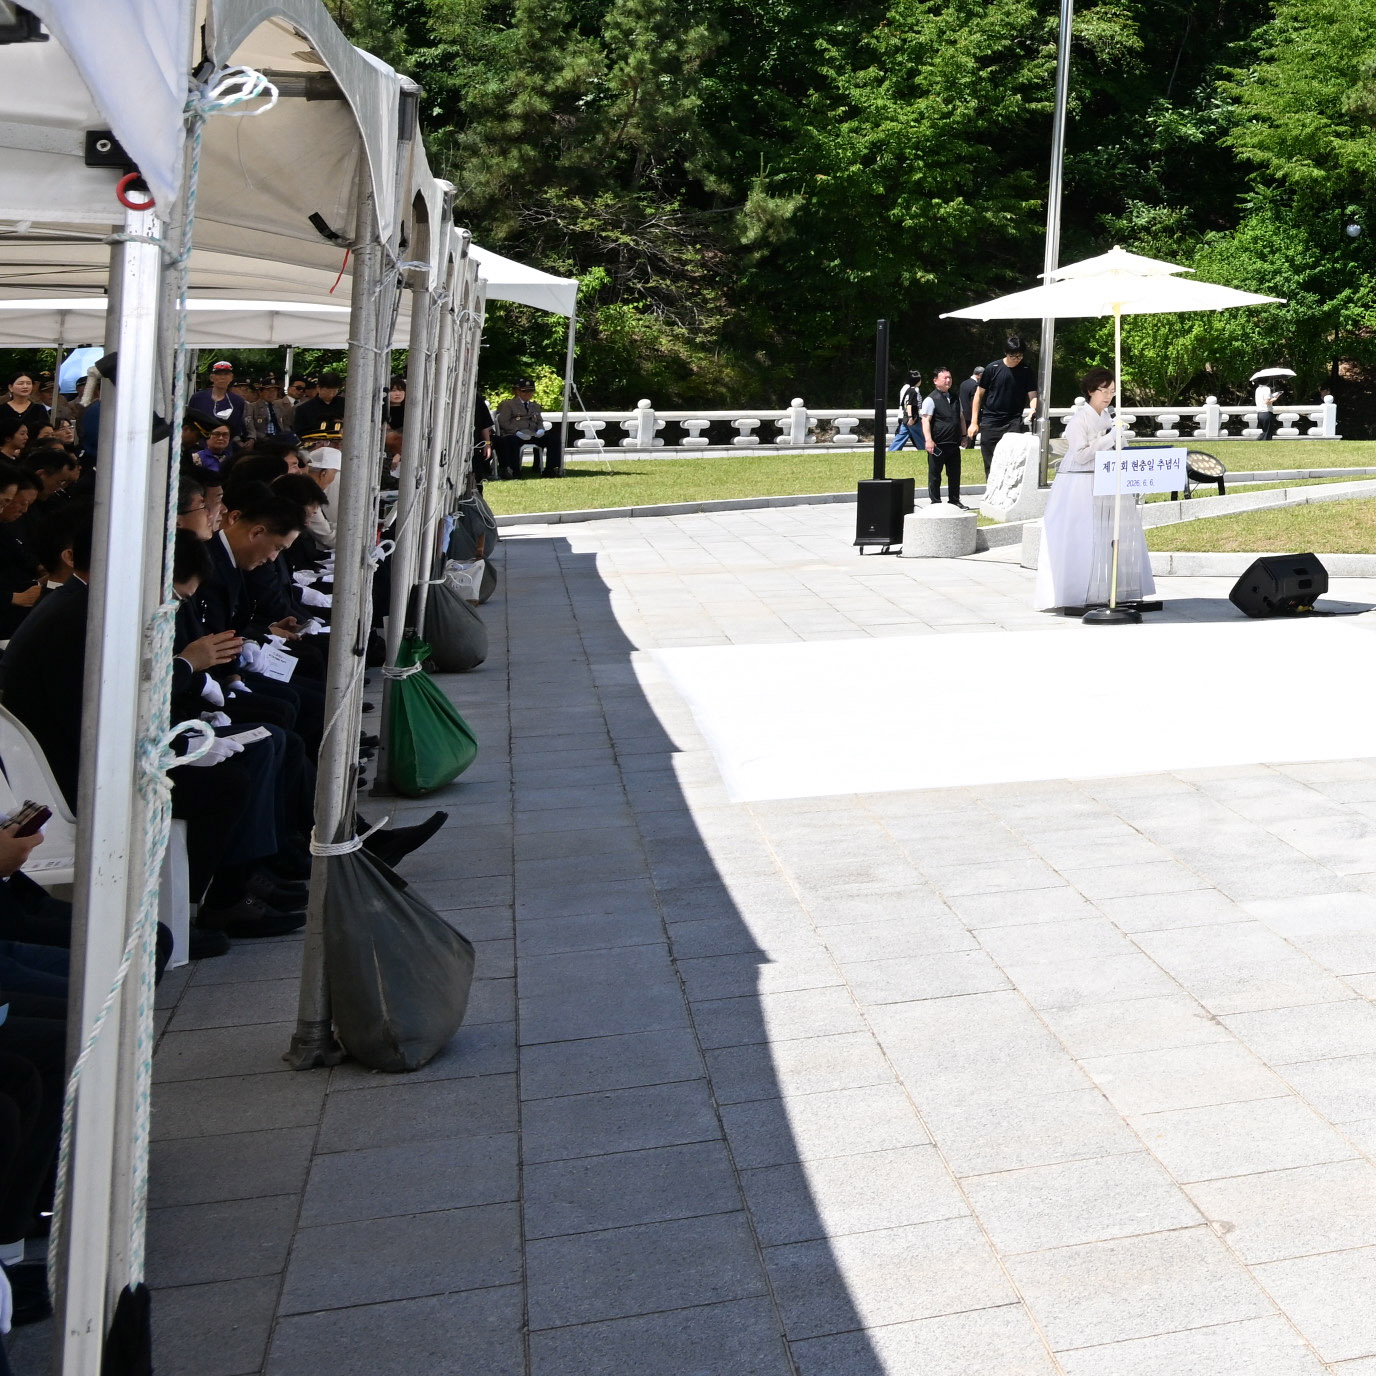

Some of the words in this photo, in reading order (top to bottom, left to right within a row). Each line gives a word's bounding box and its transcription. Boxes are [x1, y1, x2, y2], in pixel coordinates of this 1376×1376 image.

[1103, 460, 1128, 473] 제7회
[1132, 459, 1155, 472] 현충일
[1157, 458, 1180, 471] 추념식
